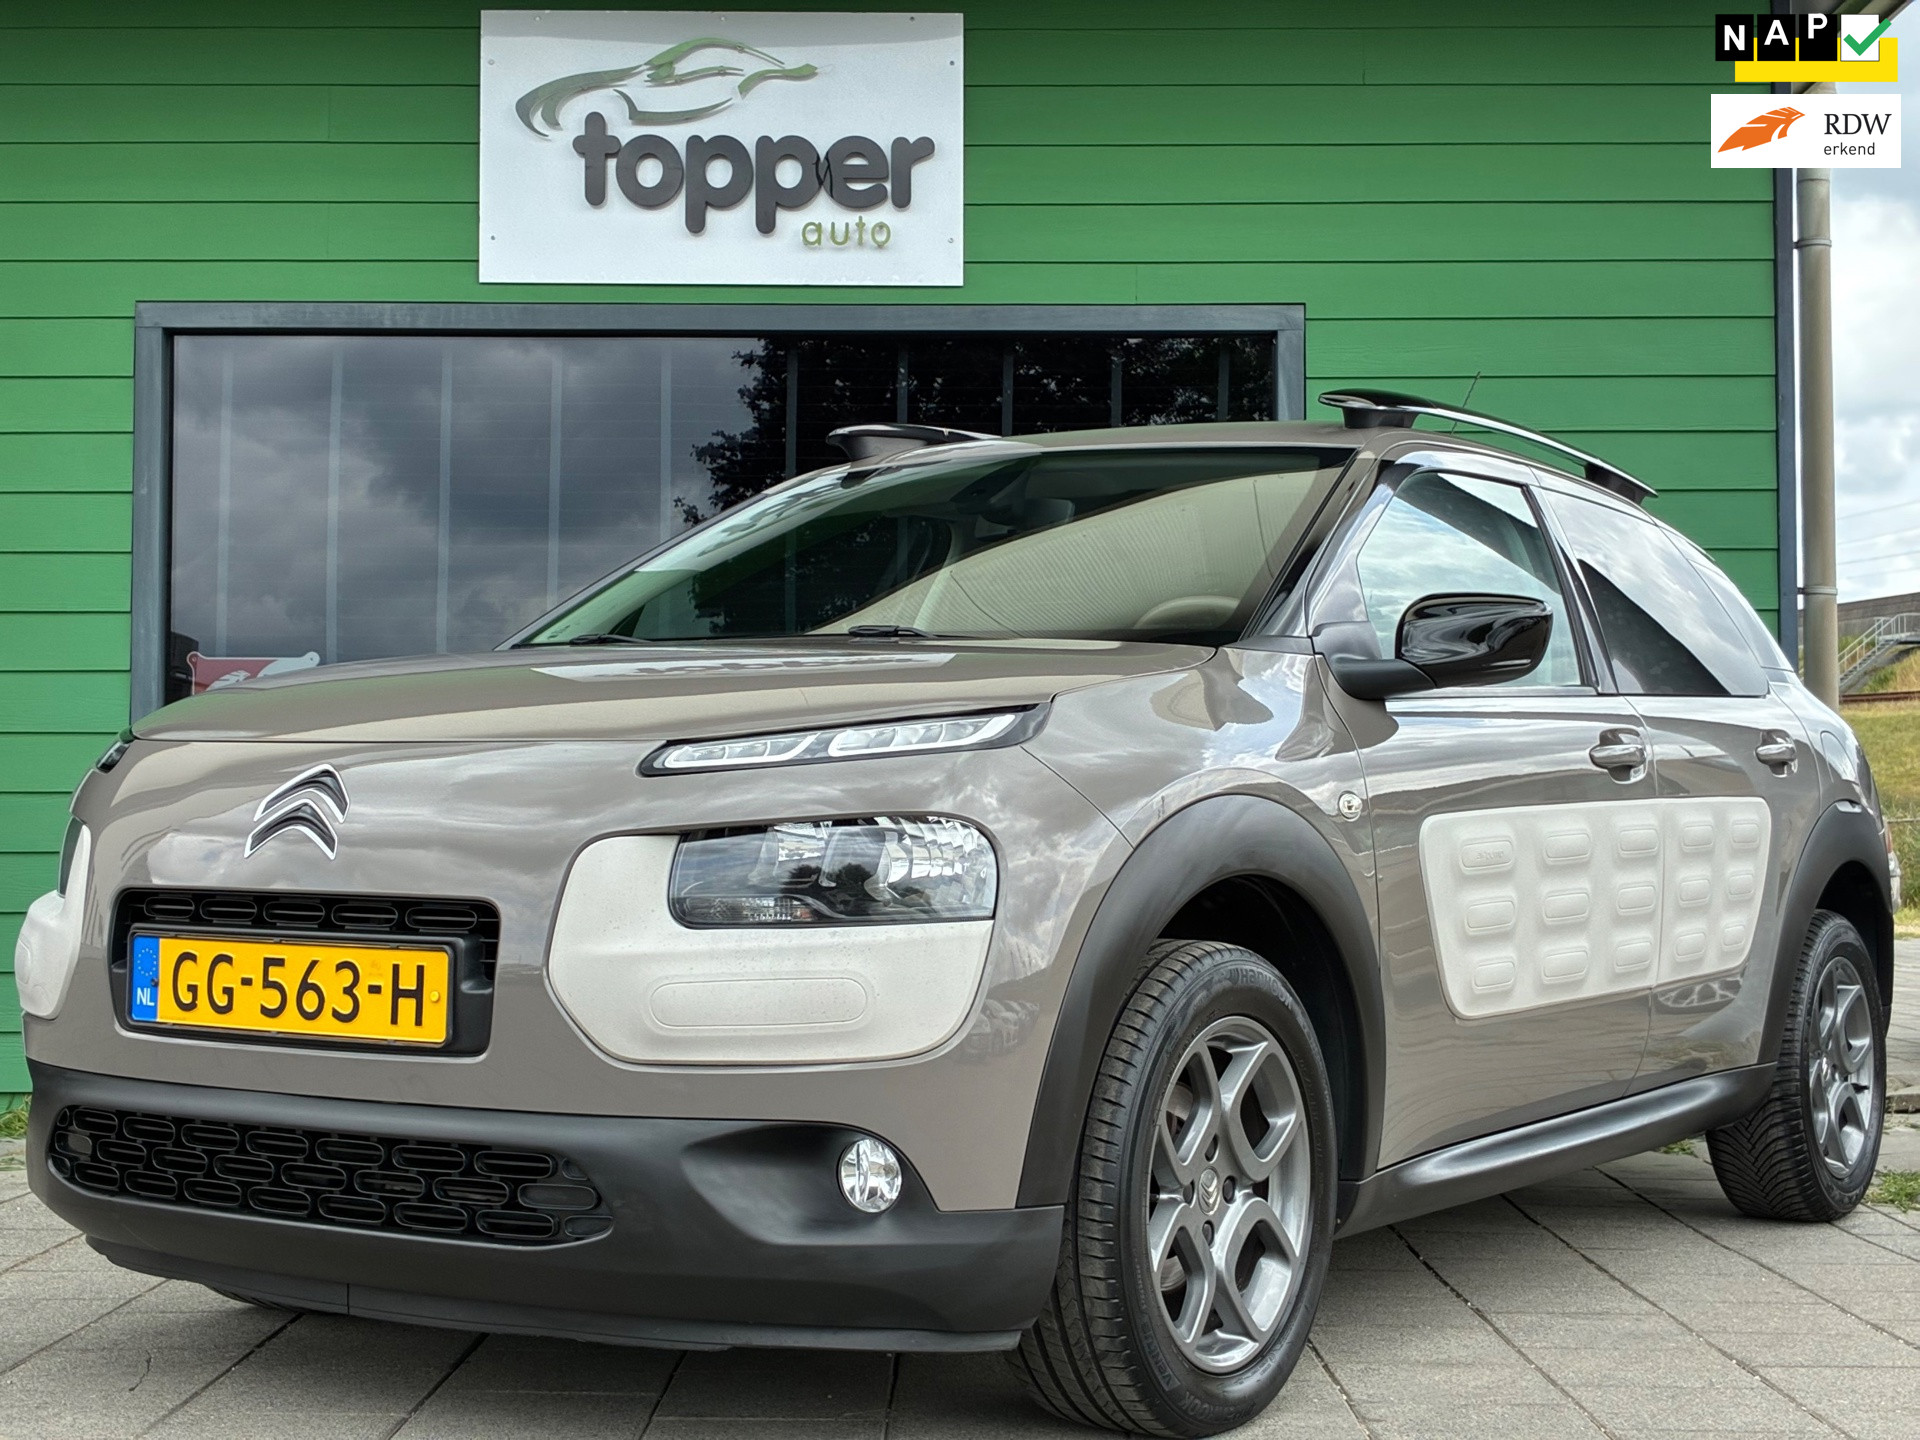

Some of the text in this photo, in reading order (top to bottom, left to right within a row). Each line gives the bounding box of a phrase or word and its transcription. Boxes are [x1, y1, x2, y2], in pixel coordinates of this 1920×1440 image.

[572, 111, 936, 235] topper
[801, 215, 892, 248] auto
[136, 986, 156, 1007] NL
[171, 951, 426, 1027] GG-563-H
